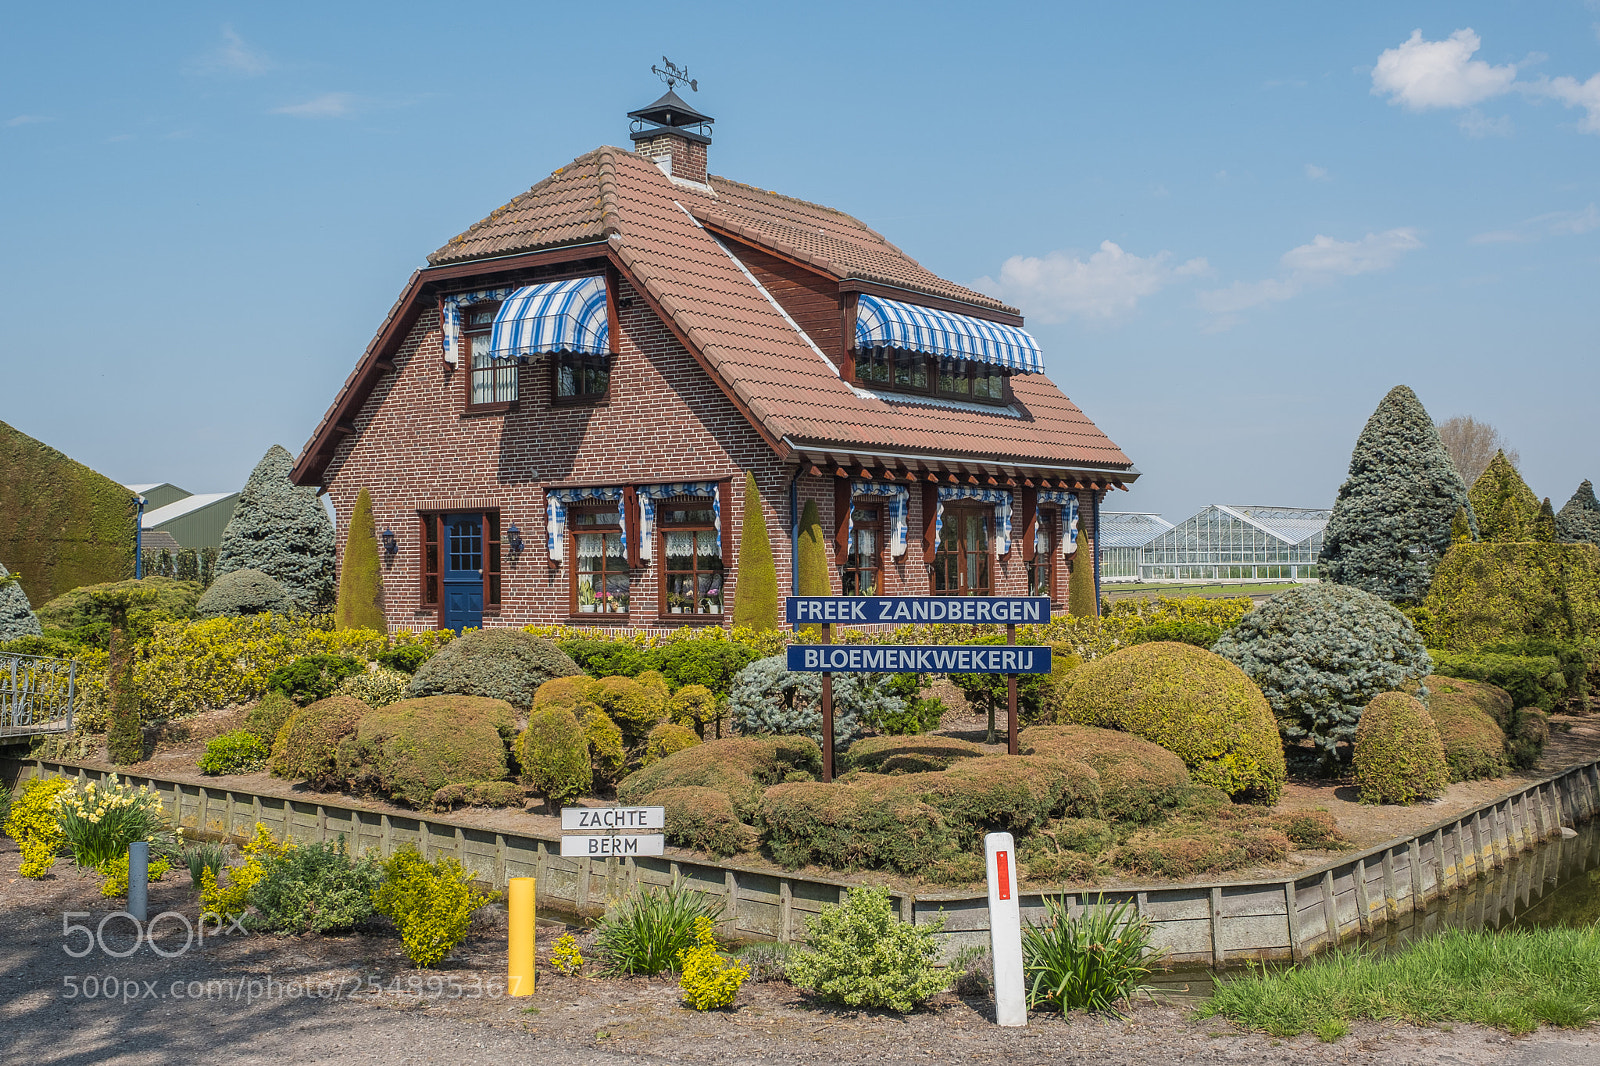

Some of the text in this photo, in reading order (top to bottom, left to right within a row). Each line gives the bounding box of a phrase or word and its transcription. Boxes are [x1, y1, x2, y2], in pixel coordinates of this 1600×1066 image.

[796, 601, 1040, 620] FREEK ZANDBERGEN
[804, 649, 1033, 670] BLOEMENKWEKERIJ
[579, 810, 648, 827] ZACHTE
[588, 838, 638, 854] BERM
